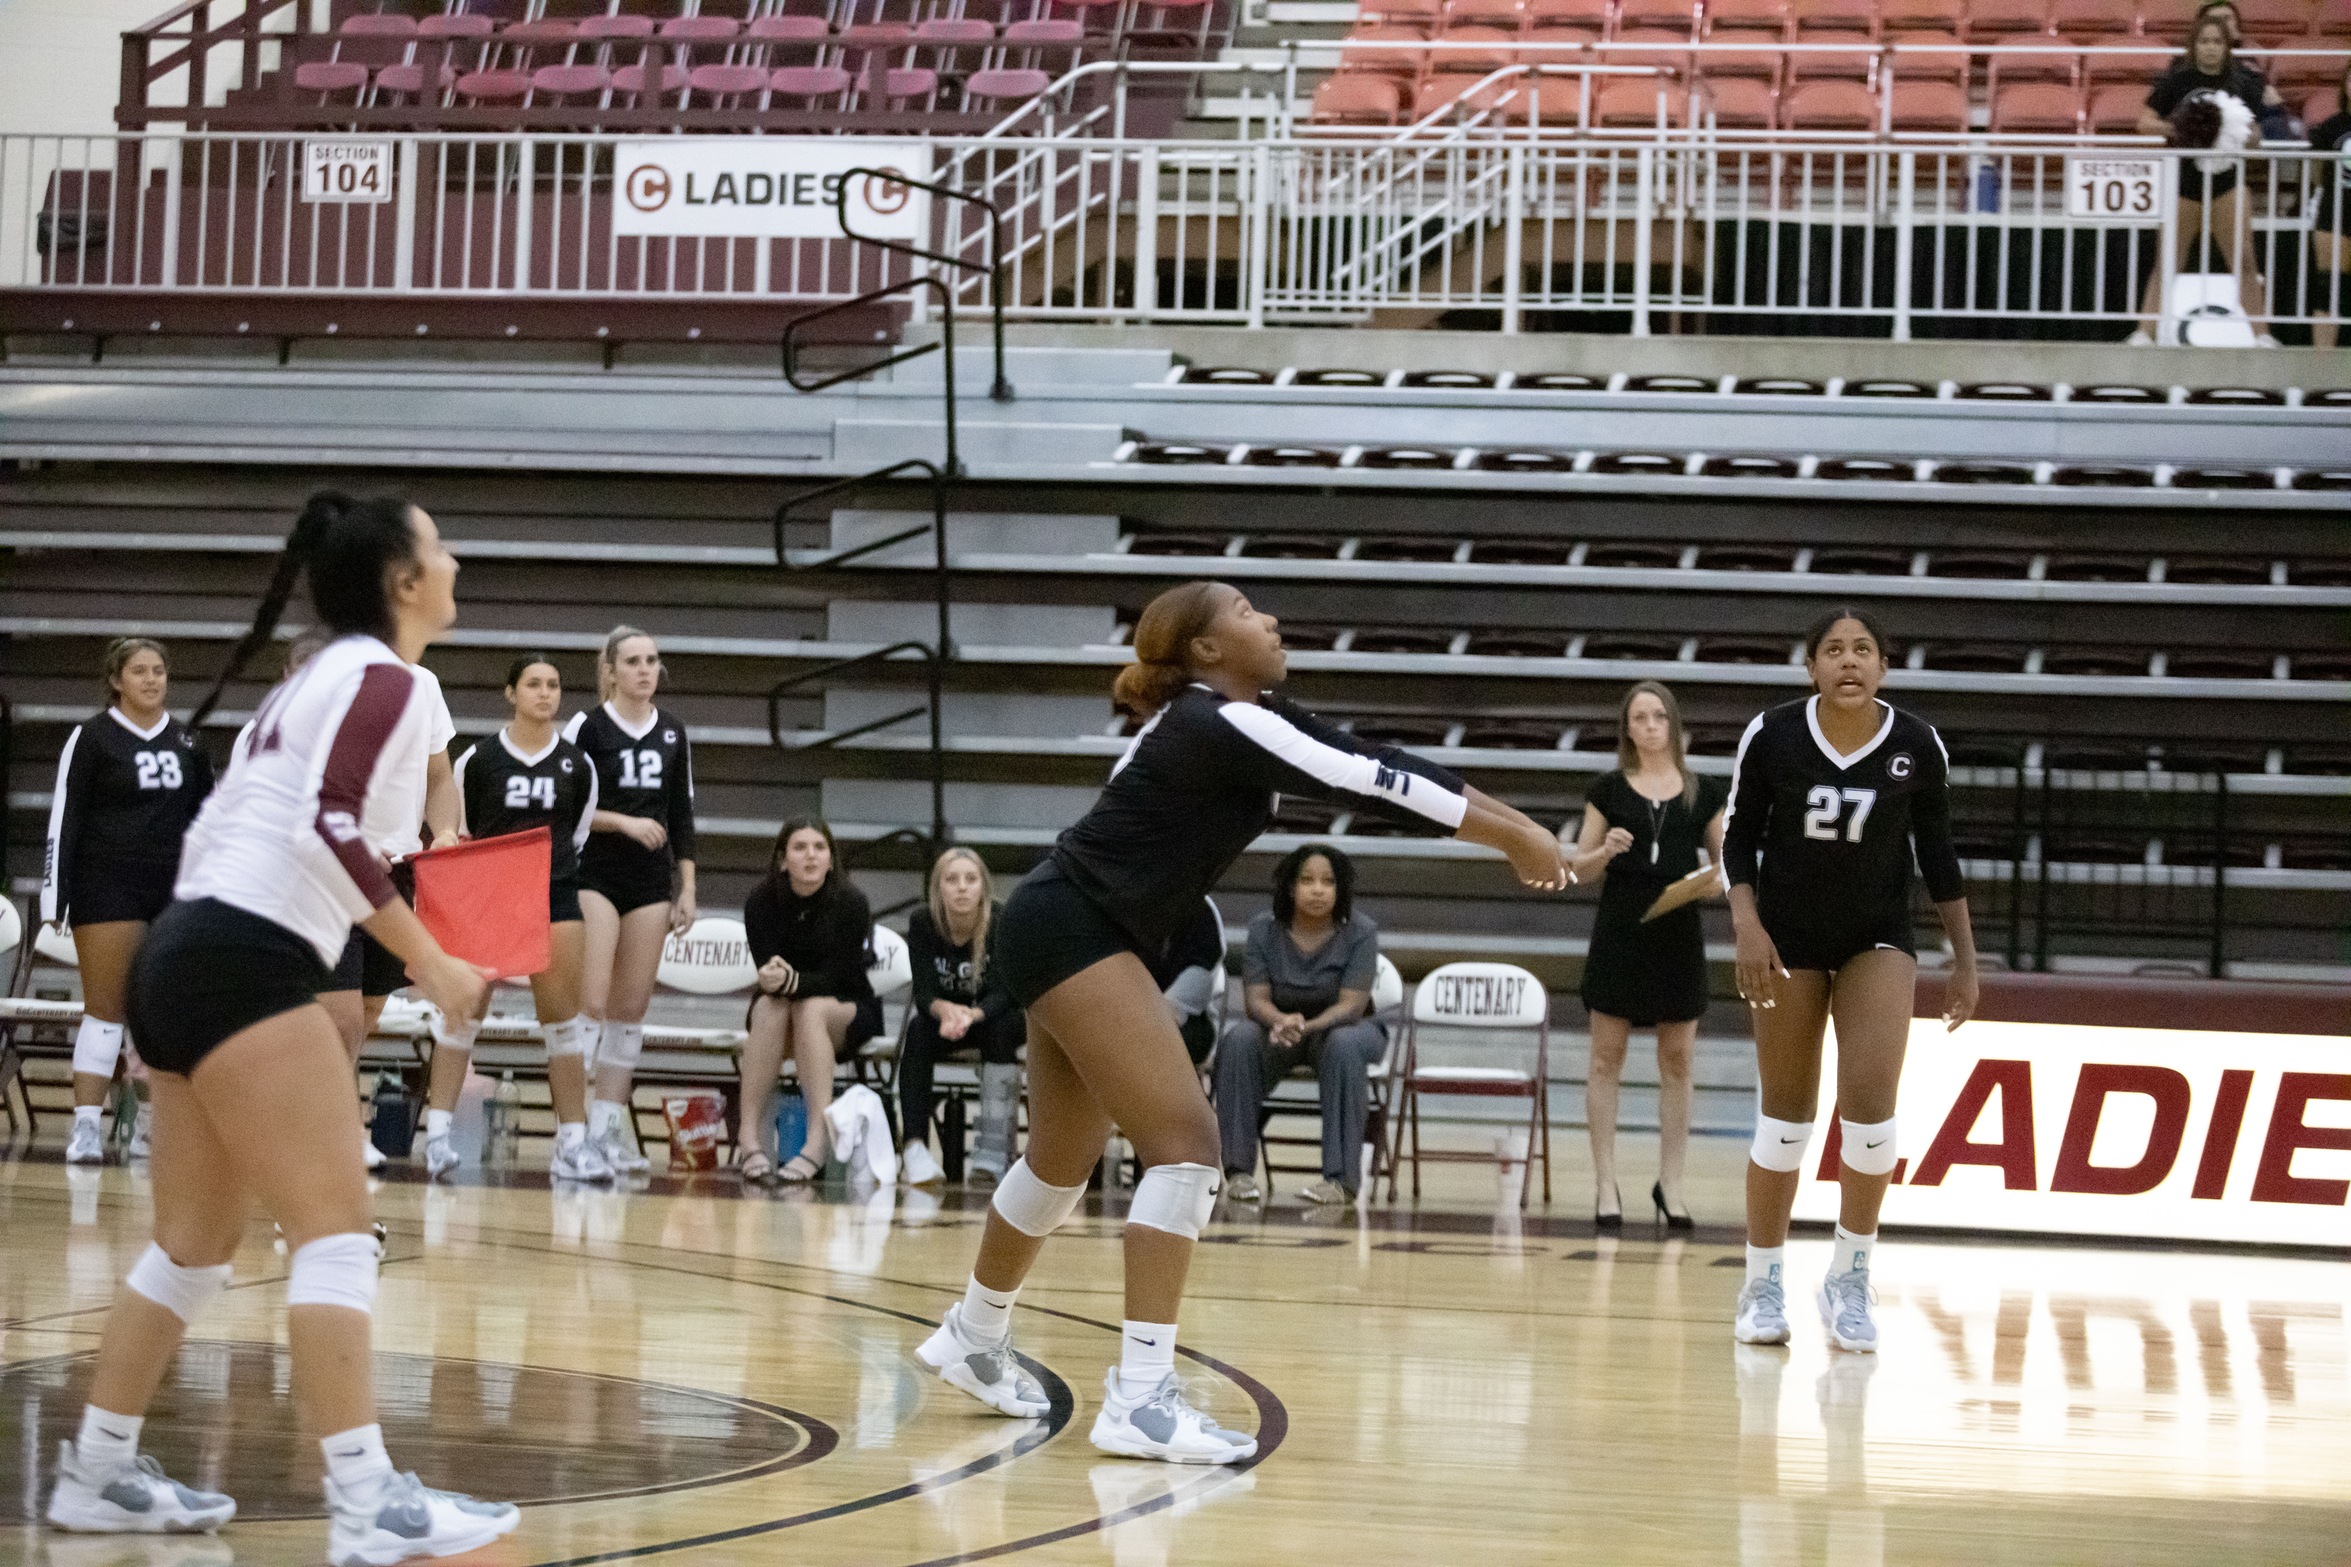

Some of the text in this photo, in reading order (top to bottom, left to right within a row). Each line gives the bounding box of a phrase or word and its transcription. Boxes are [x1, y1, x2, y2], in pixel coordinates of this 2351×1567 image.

[315, 146, 379, 160] SECTION
[317, 163, 380, 193] 104
[685, 172, 845, 206] LADIES
[2080, 180, 2152, 211] 103
[134, 750, 184, 790] 23
[618, 748, 663, 789] 12
[1890, 756, 1911, 777] C
[504, 775, 557, 810] 24
[1804, 784, 1877, 843] 27
[664, 939, 750, 967] CENTENARY
[1434, 975, 1526, 1016] CENTENARY
